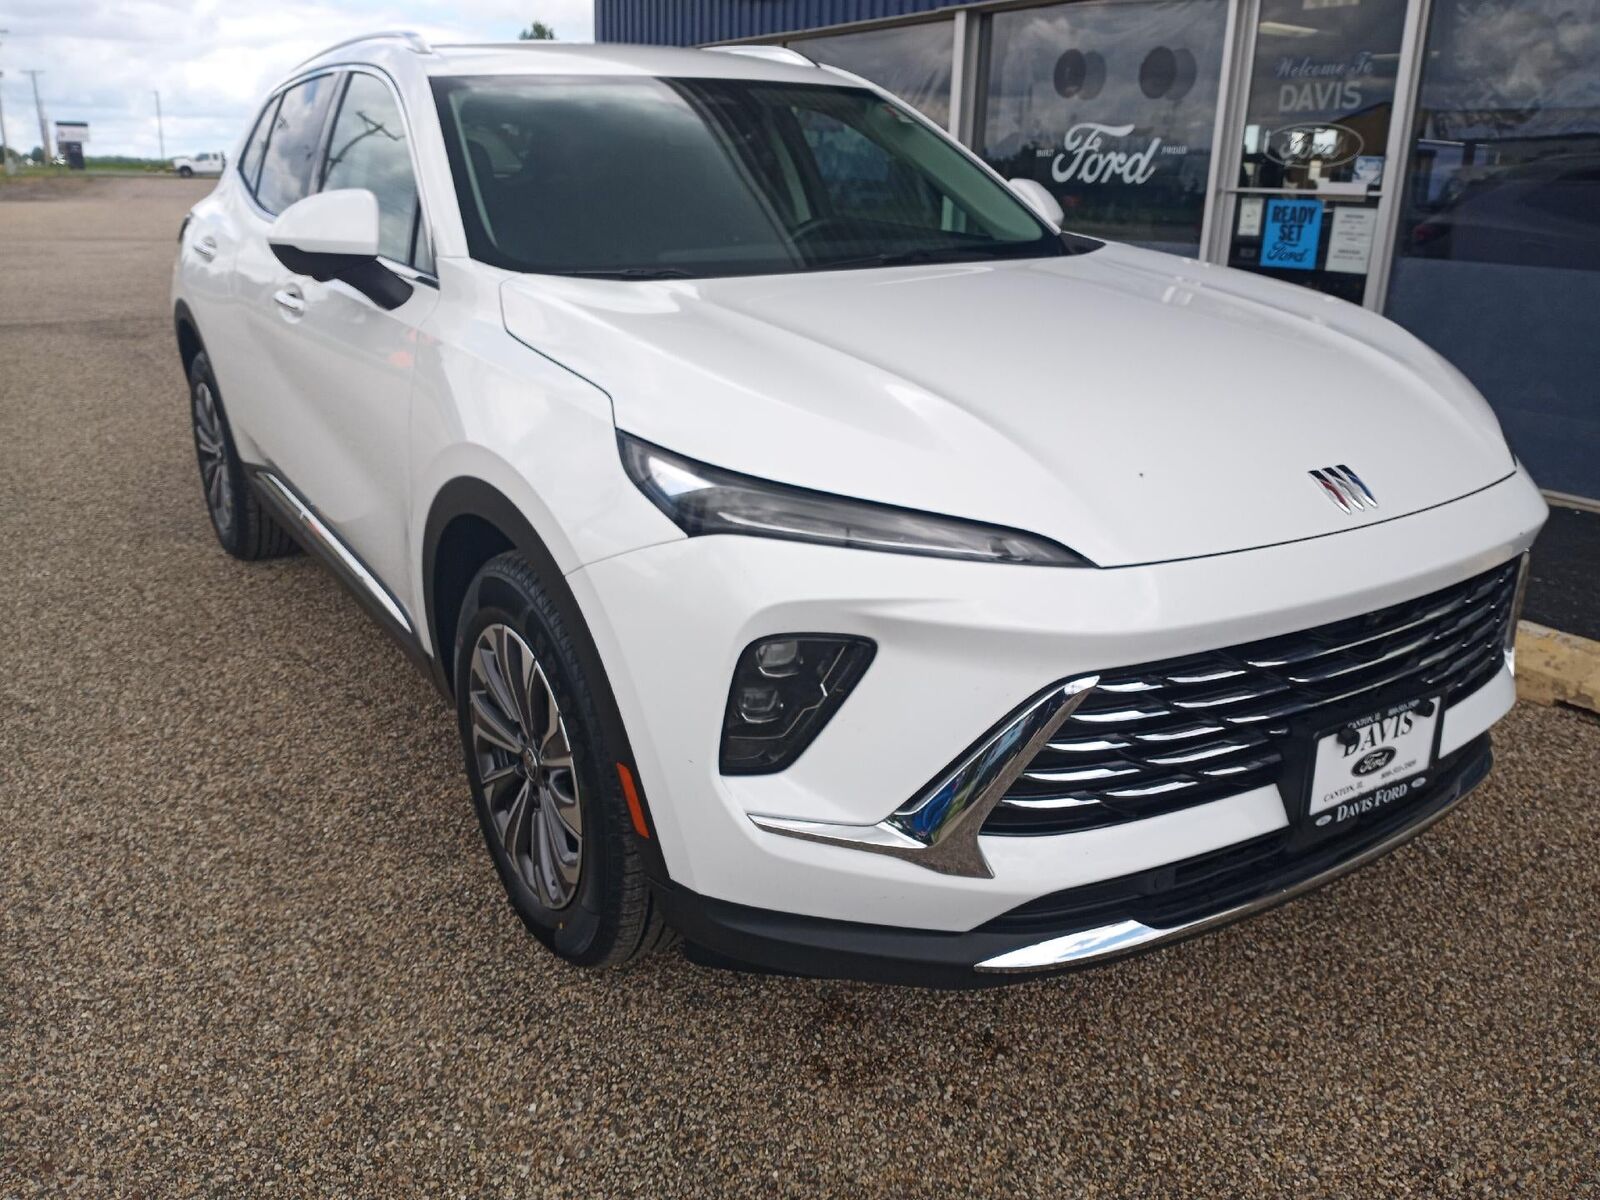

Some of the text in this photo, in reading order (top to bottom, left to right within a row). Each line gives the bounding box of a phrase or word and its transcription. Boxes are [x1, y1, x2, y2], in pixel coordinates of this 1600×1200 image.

[1275, 56, 1345, 78] Welcome
[1278, 80, 1363, 112] DAVIS
[1051, 122, 1162, 184] Ford
[1279, 126, 1344, 160] Ford
[1271, 205, 1317, 225] READY
[1278, 224, 1304, 242] SET
[1266, 241, 1309, 263] Ford
[1342, 711, 1414, 758] DAVIS
[1359, 751, 1390, 774] Ford
[1323, 785, 1355, 803] CANTON
[1336, 797, 1374, 823] DAVIS
[1374, 783, 1408, 807] FORD
